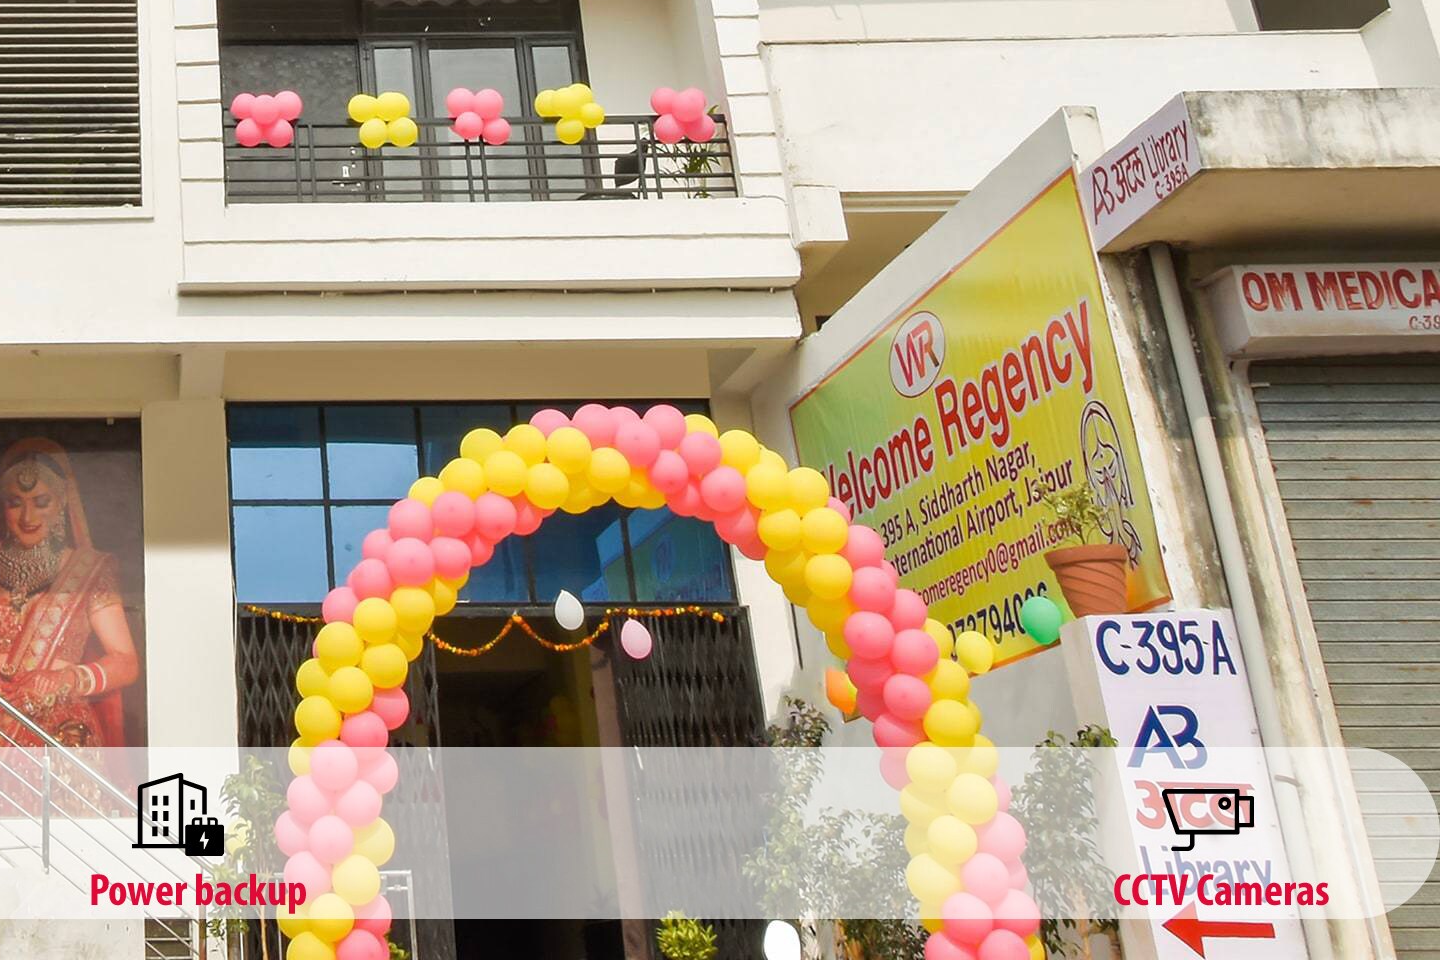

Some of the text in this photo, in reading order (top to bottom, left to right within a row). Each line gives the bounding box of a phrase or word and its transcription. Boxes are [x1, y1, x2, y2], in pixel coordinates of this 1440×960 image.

[1111, 146, 1147, 204] अटल
[1141, 120, 1189, 179] Library
[1241, 271, 1304, 312] OM
[895, 320, 939, 387] WR
[934, 301, 1093, 457] Regency
[919, 465, 985, 526] Siddharth
[985, 441, 1036, 488] Nagar,
[884, 515, 964, 577] ternational
[966, 487, 1023, 539] Airport,
[1126, 704, 1209, 770] AB
